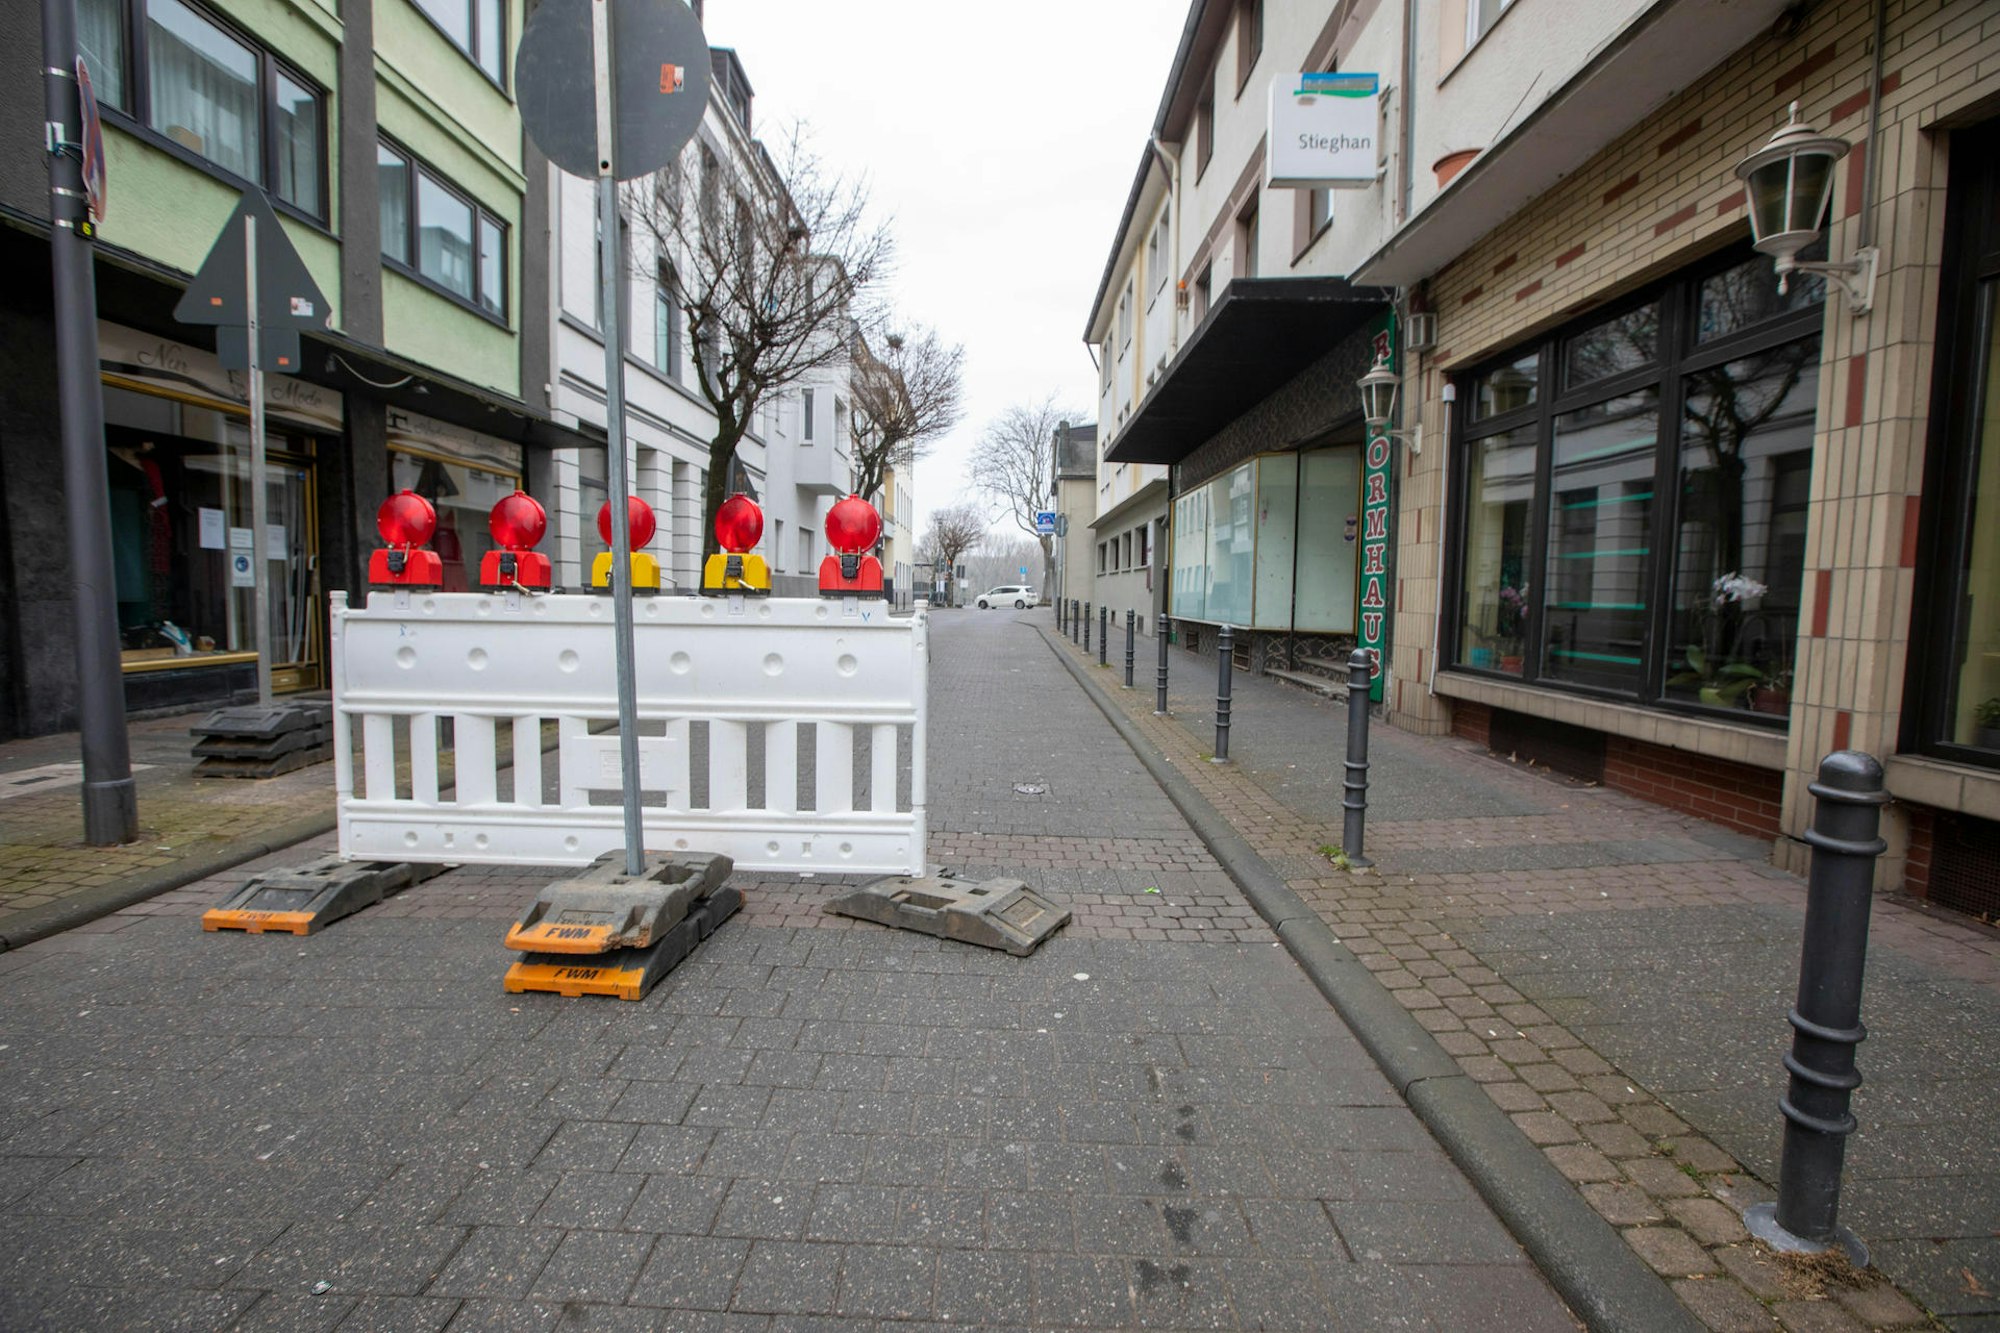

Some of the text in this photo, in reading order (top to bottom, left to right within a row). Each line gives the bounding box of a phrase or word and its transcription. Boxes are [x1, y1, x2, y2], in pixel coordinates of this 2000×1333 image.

[1299, 133, 1371, 154] Stieghan
[1362, 329, 1393, 679] RORMHAUS
[544, 926, 592, 940] FWM
[554, 967, 600, 980] FWM
